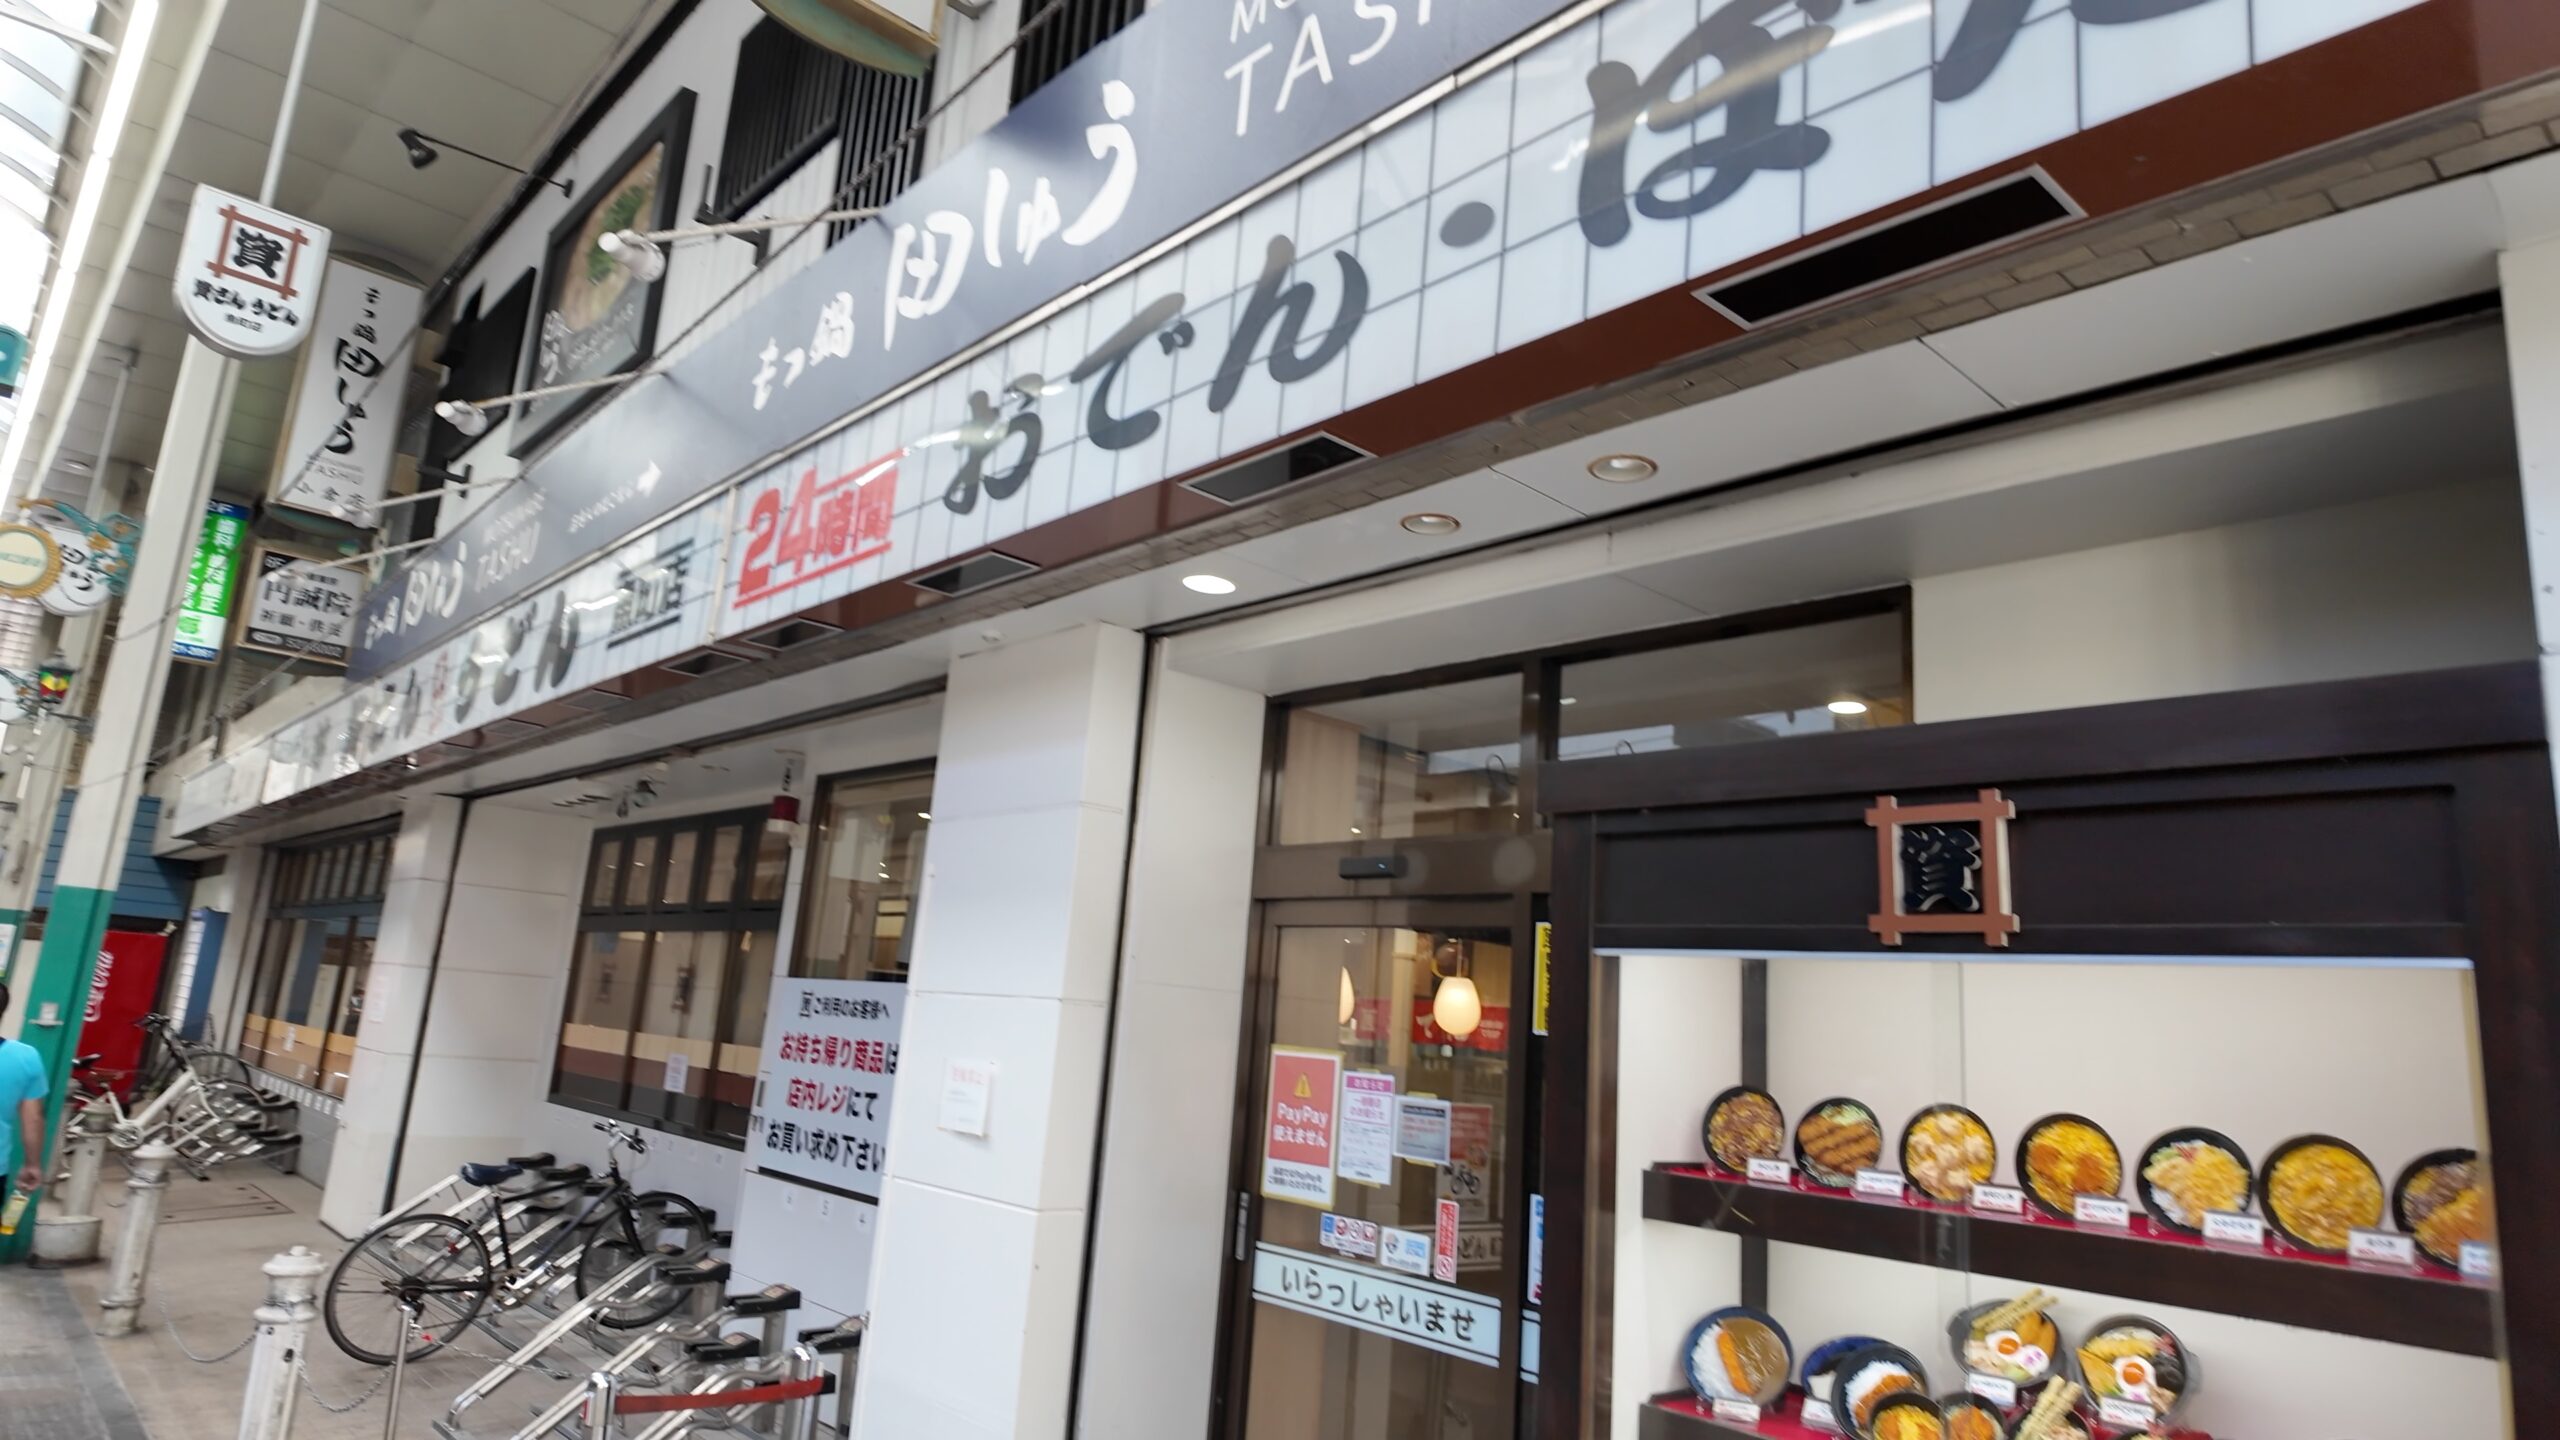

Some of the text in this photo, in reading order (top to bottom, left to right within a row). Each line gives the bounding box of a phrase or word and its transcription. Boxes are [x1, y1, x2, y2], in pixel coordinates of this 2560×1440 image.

[233, 226, 284, 279] 資
[752, 79, 1138, 410] もつ鍋 田しゅう
[1277, 1102, 1329, 1128] PayPay
[1281, 1264, 1475, 1343] いらっしゃいませ
